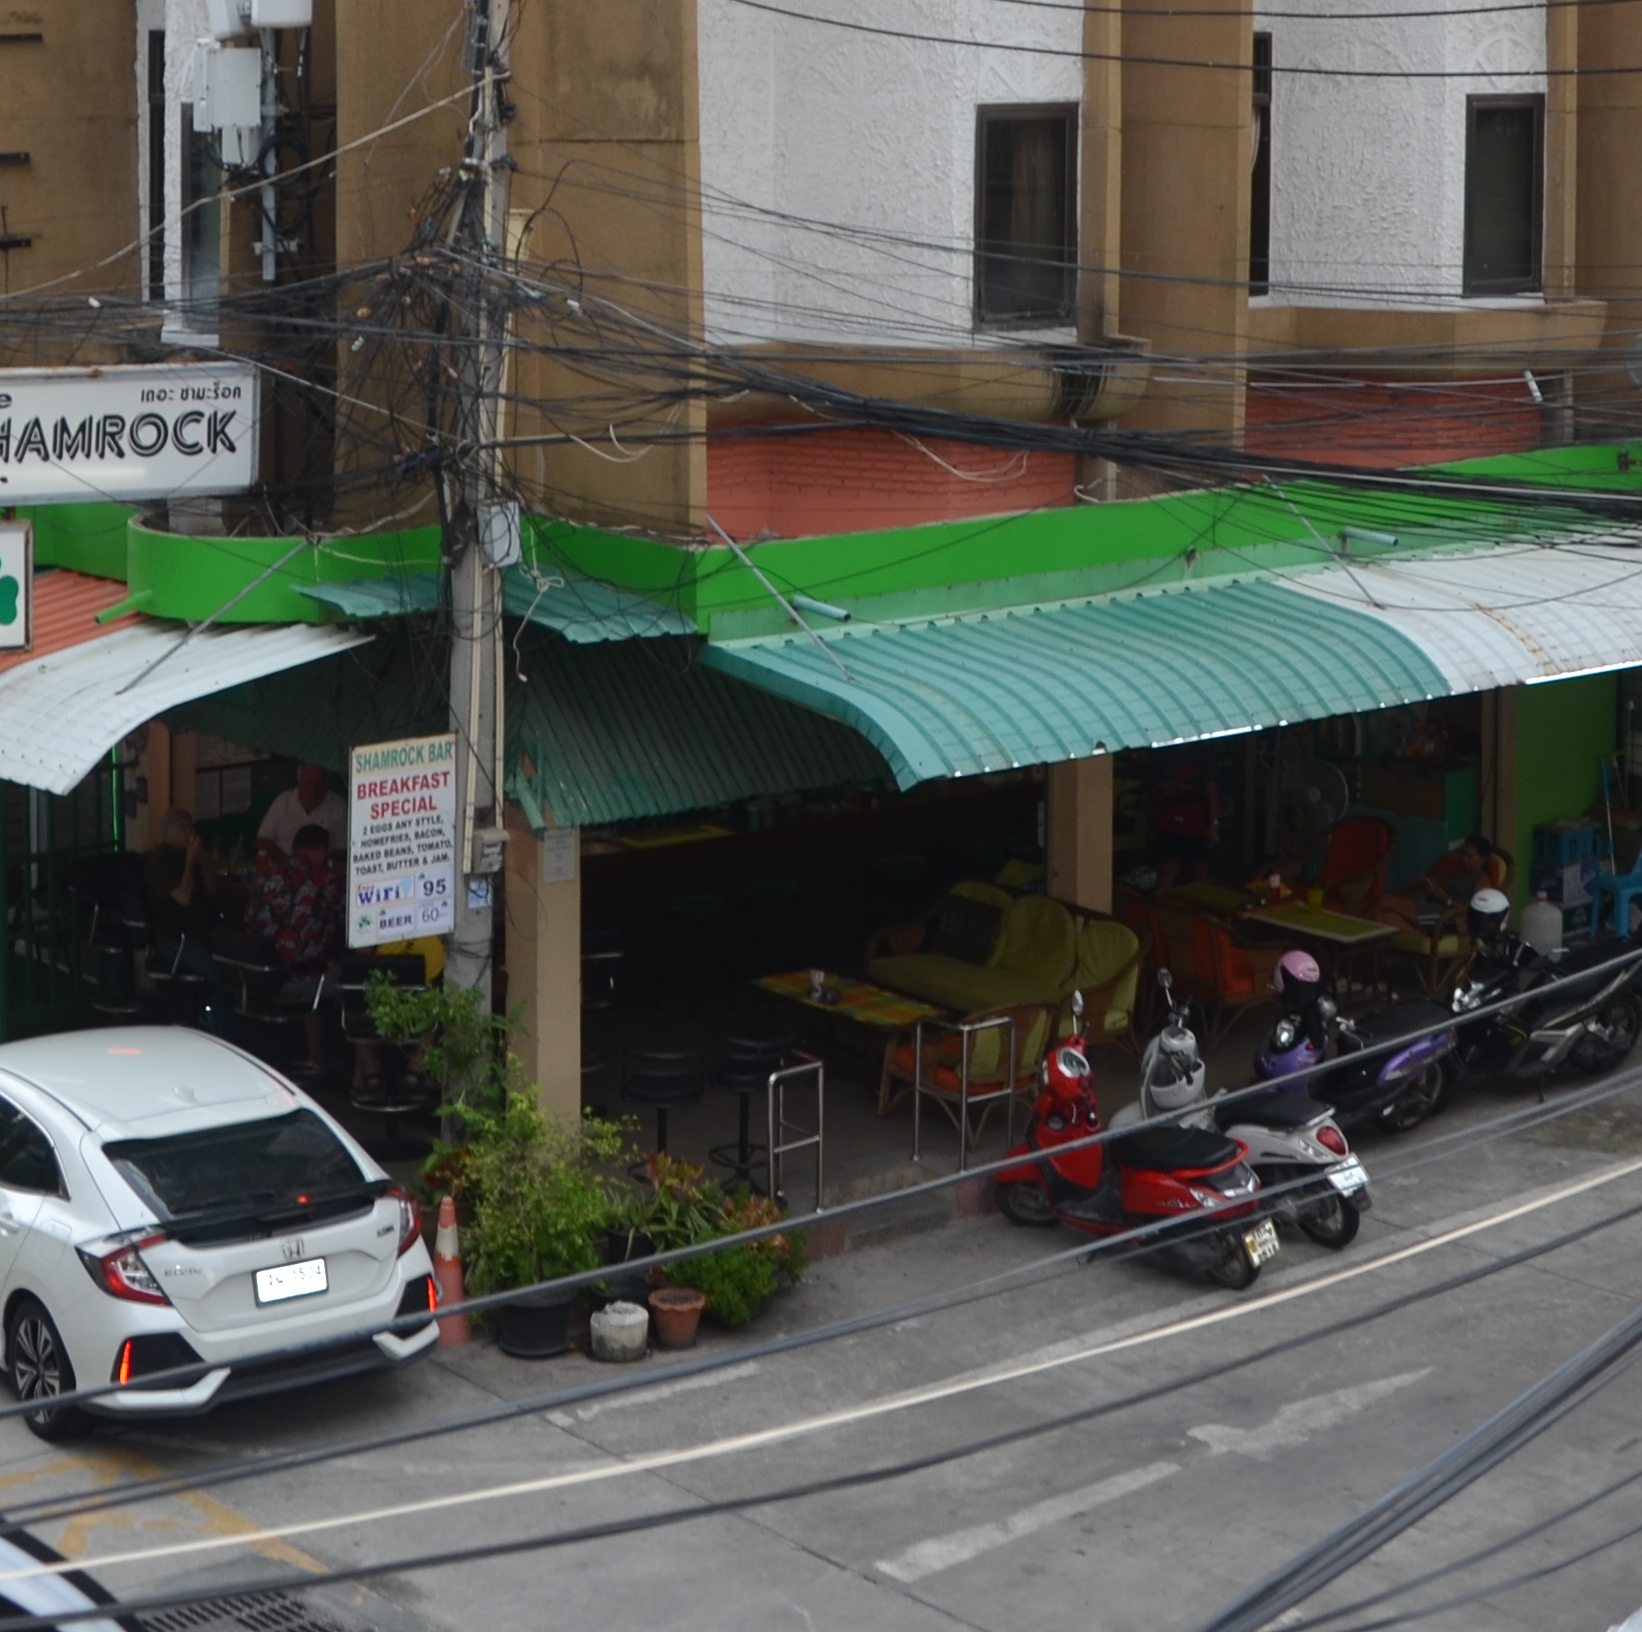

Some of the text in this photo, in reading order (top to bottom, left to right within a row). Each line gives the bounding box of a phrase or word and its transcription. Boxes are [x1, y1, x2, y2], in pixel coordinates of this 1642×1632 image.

[356, 741, 452, 773] SHAMROCK BAR
[358, 771, 450, 800] BREAKFAST
[371, 795, 437, 820] SPECIAL
[363, 826, 367, 836] 2
[370, 823, 392, 834] EGGS
[395, 819, 412, 829] ANY
[361, 832, 411, 848] HOMEFRIES,
[353, 851, 381, 863] BAKED
[384, 846, 414, 858] BEANS,
[356, 864, 384, 876] TOAST,
[386, 858, 419, 871] BUTTER
[422, 856, 428, 865] &
[423, 878, 446, 897] 95
[379, 914, 412, 929] BEER
[422, 907, 439, 923] 60
